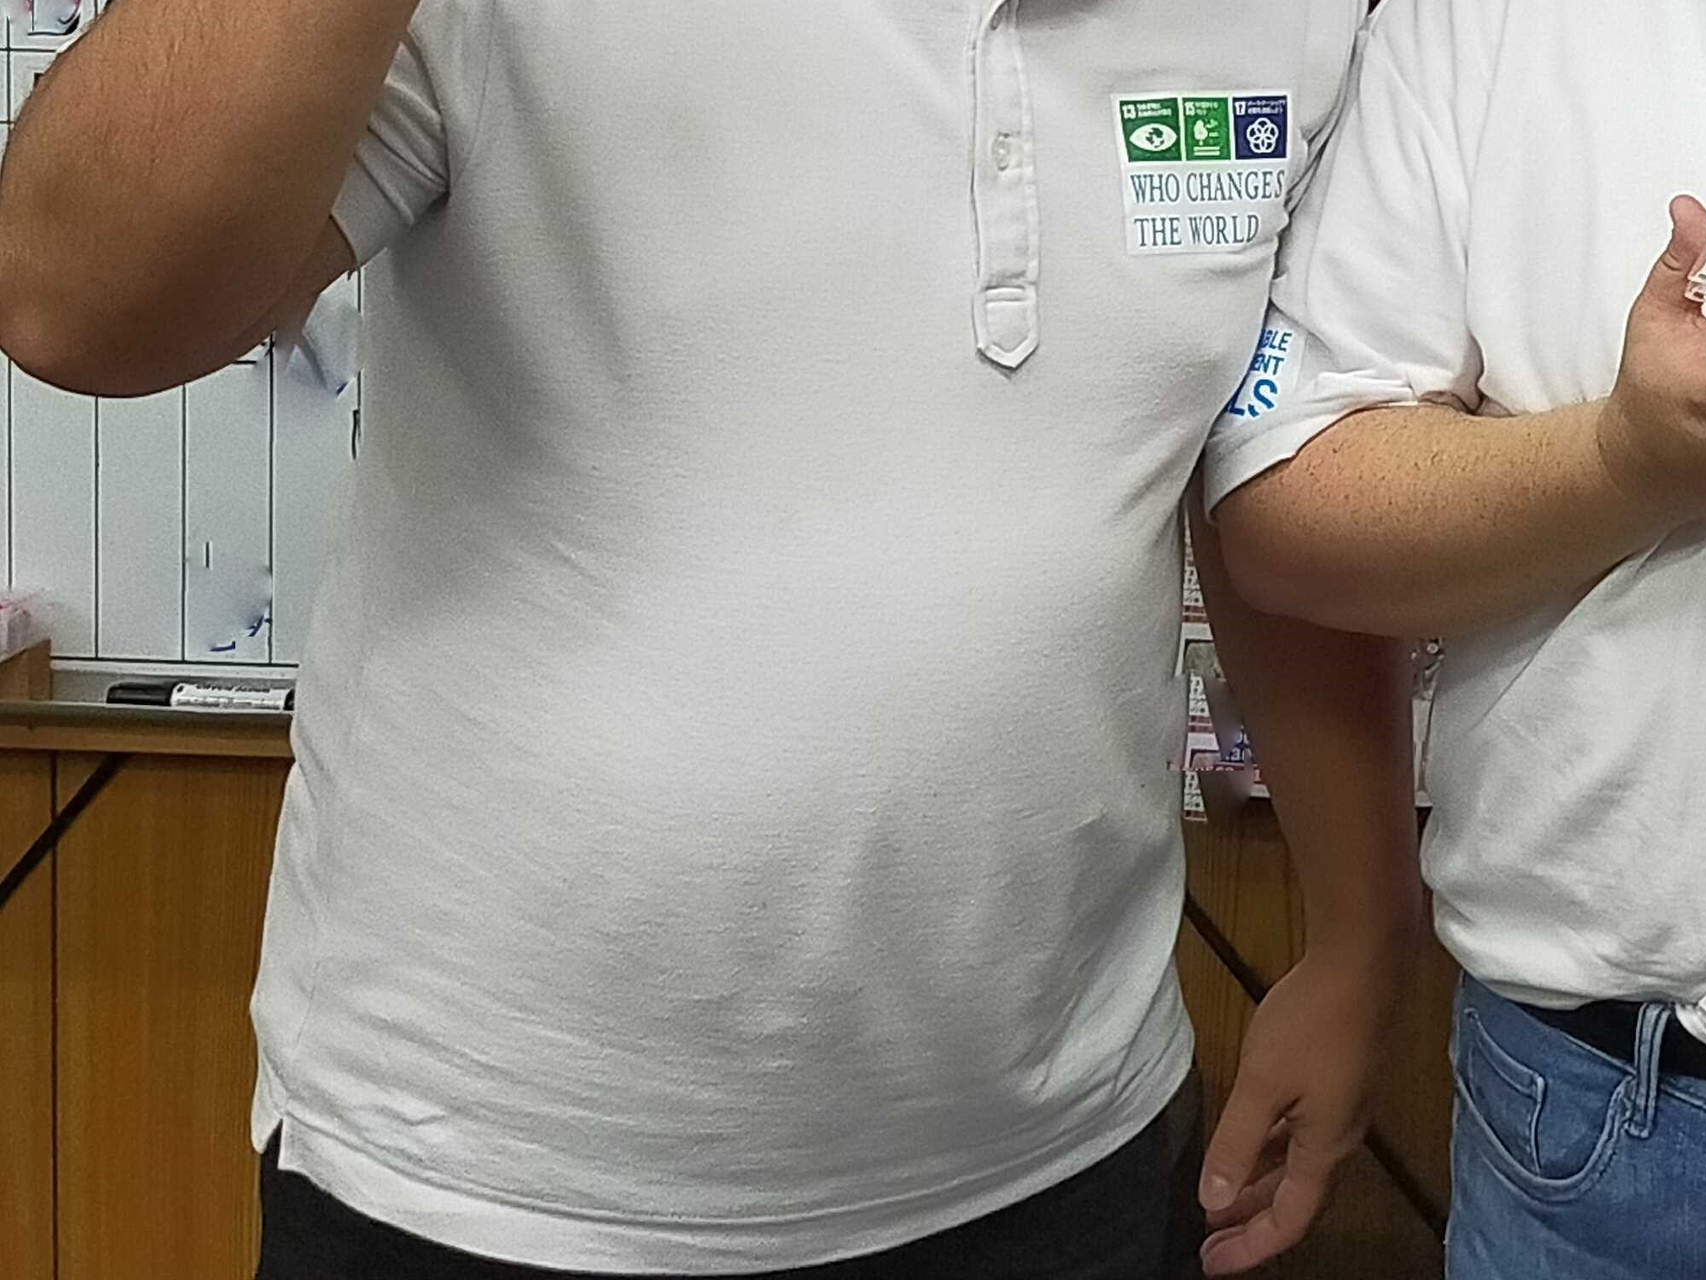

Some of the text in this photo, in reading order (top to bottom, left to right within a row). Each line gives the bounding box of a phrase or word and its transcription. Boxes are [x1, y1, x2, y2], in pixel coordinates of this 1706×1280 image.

[1235, 101, 1246, 116] 17
[1130, 170, 1285, 203] WHO CHANGES
[1134, 214, 1260, 247] THE WORLD
